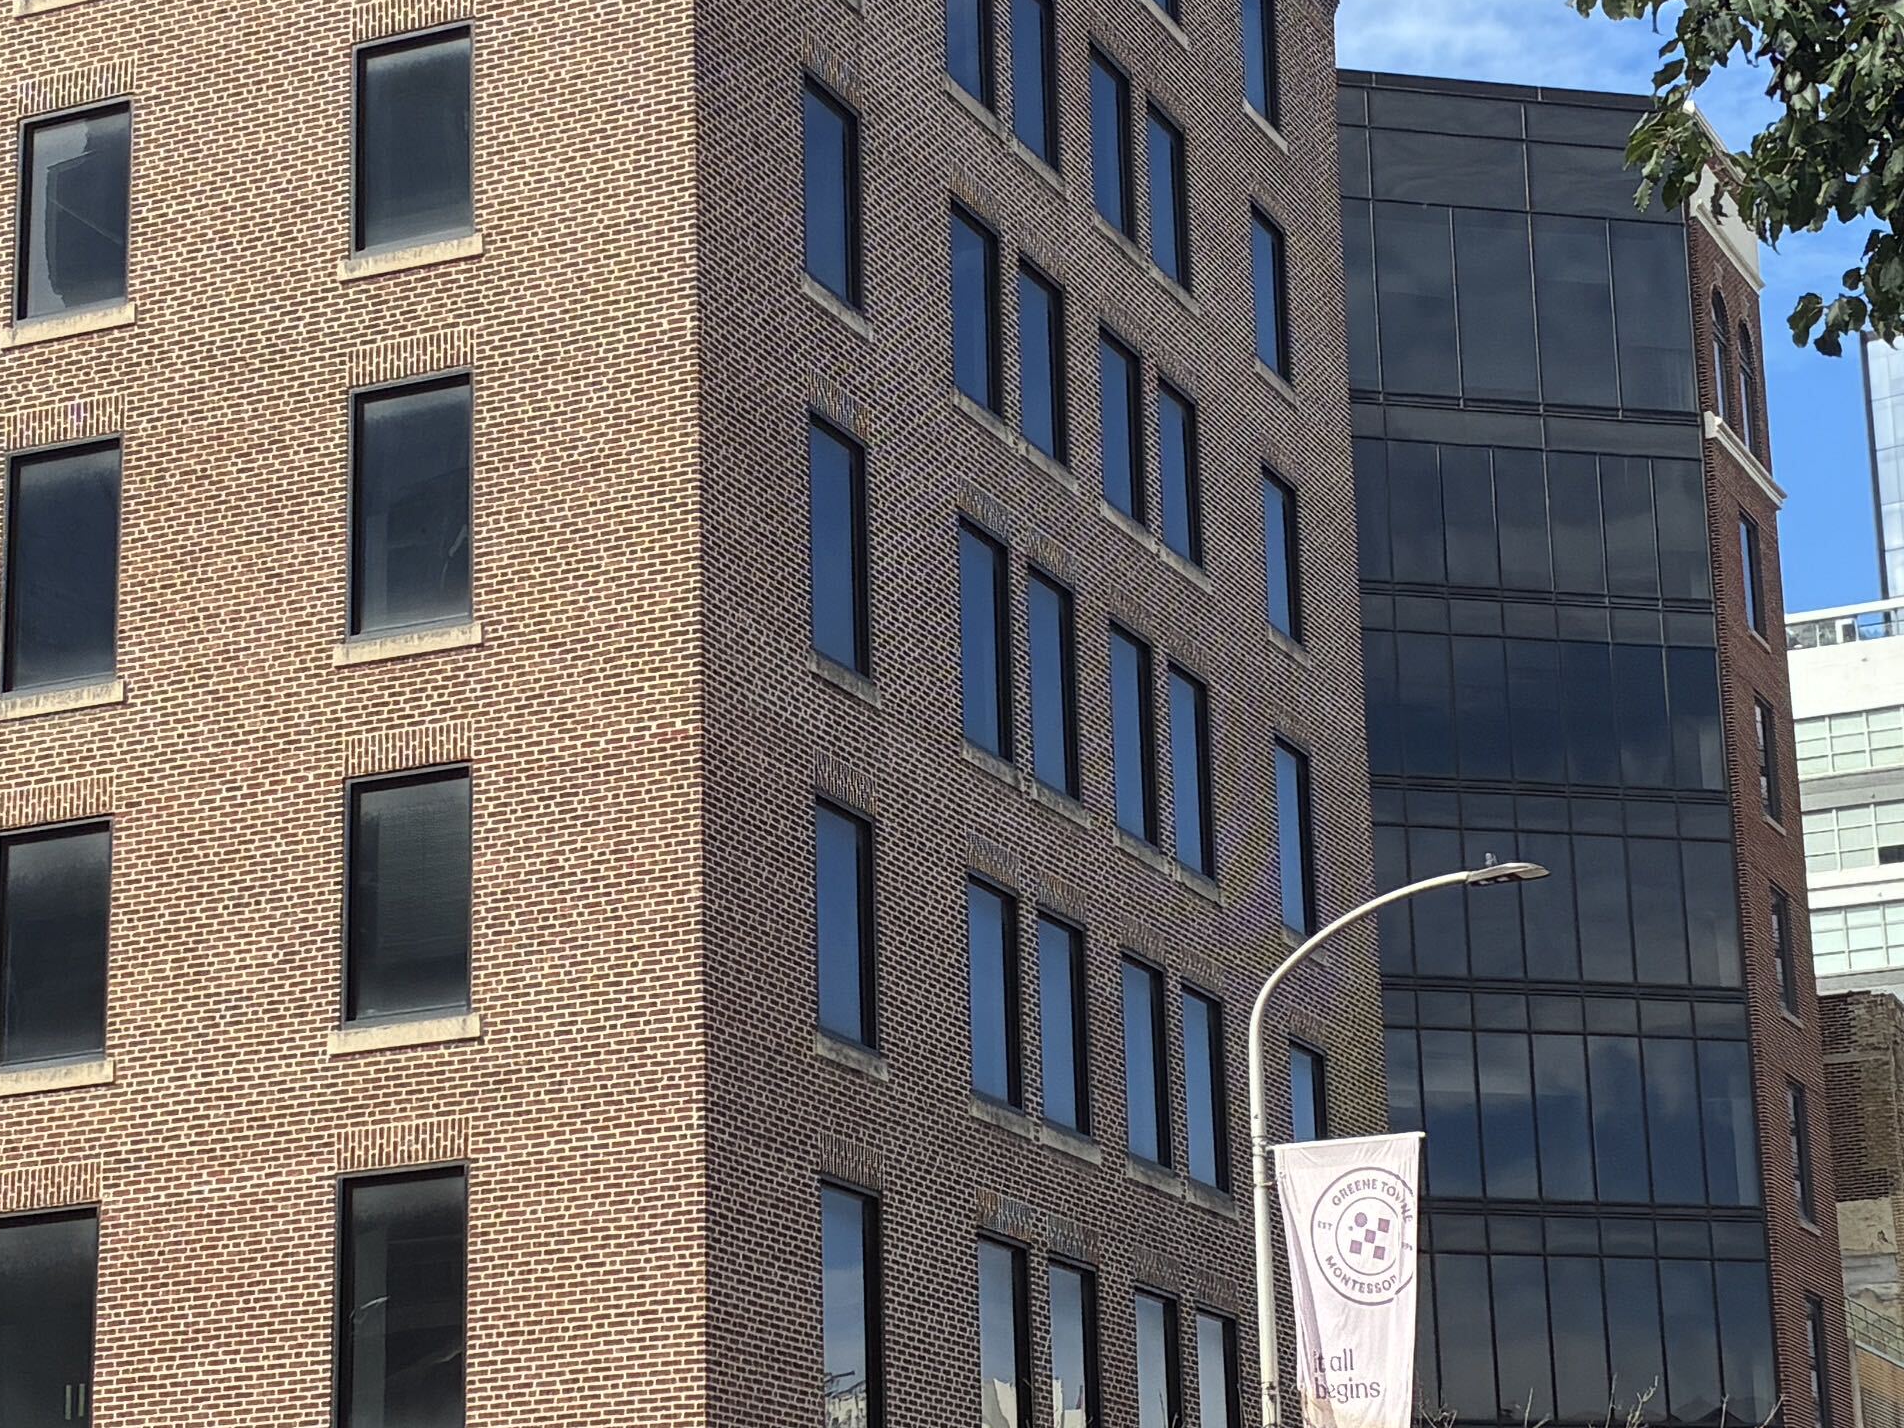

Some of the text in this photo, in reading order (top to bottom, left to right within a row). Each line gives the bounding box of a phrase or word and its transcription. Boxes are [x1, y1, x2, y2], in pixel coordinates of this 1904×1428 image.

[1331, 1178, 1378, 1207] GREENE
[1325, 1255, 1398, 1294] MONTESSOR
[1313, 1348, 1355, 1373] it all
[1314, 1376, 1381, 1404] begins
